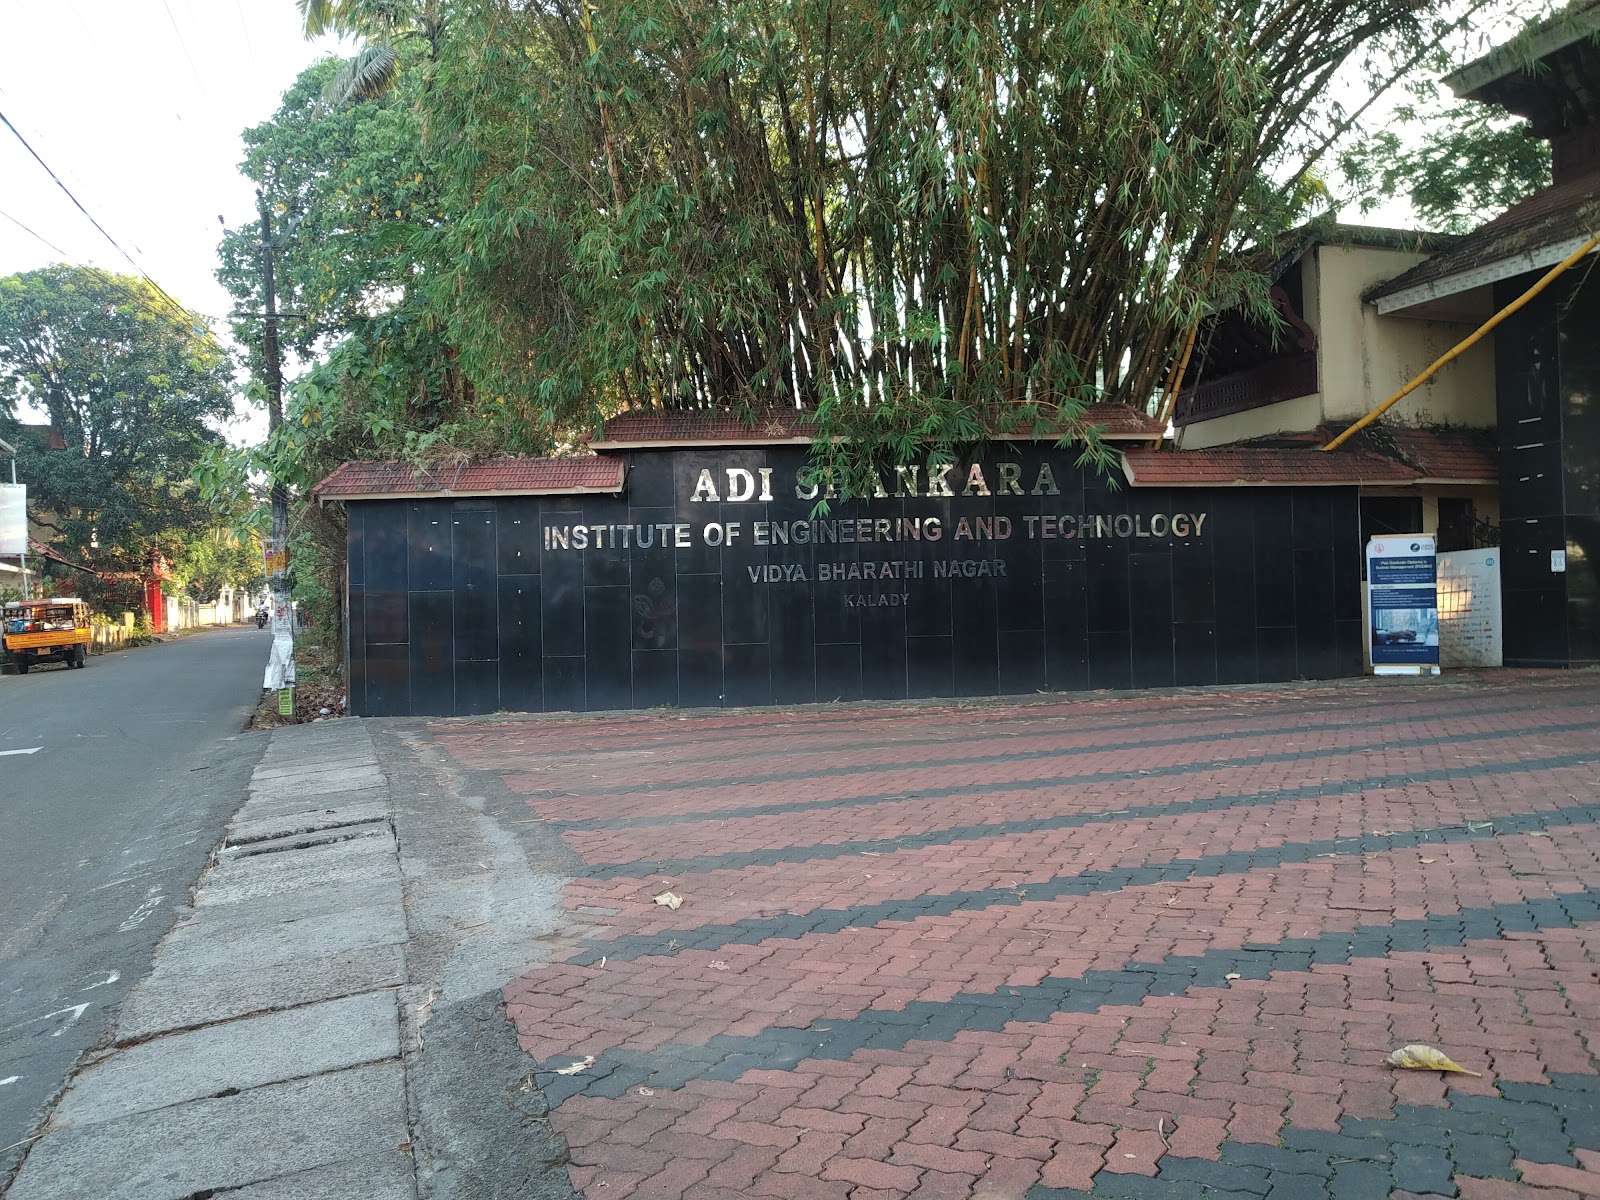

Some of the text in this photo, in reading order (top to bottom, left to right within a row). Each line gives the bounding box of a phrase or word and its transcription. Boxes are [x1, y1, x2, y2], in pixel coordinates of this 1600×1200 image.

[690, 468, 774, 502] ADI
[544, 512, 1207, 551] INSTITUTE OF ENGINEERING AND TECHNOLOGY
[747, 559, 1007, 584] VIDYA BHARATHI NAGAR
[843, 593, 910, 607] KALADY
